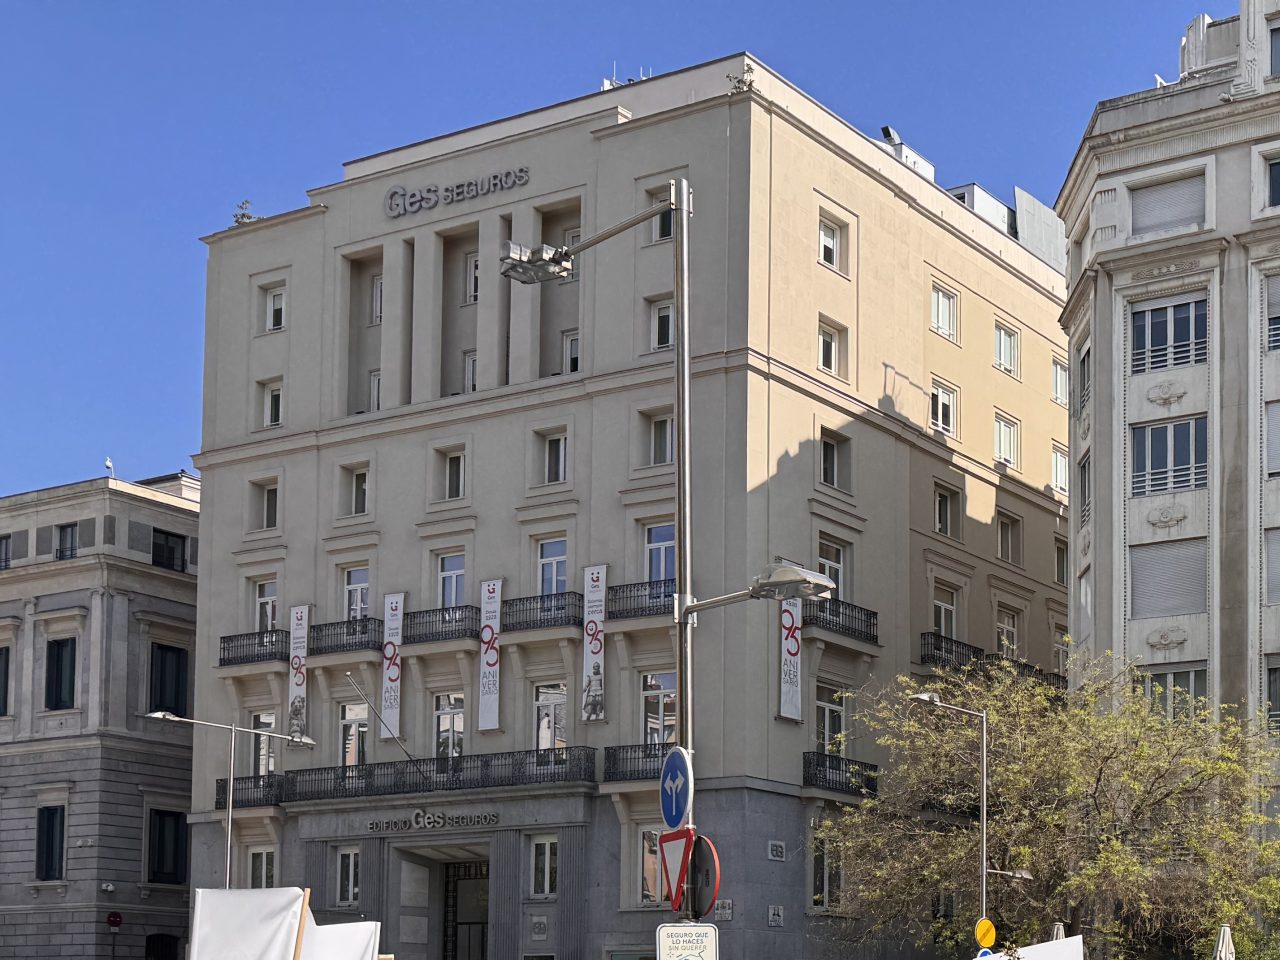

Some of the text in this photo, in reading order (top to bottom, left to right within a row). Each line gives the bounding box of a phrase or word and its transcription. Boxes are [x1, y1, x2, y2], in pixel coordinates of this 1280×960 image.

[384, 166, 529, 218] Ges SEGUROS
[586, 620, 604, 655] 95
[782, 609, 801, 657] 95
[480, 624, 499, 667] 95
[290, 655, 306, 687] 95
[383, 641, 400, 682] 95
[783, 659, 798, 671] ANI
[482, 670, 498, 680] ANI
[482, 680, 498, 689] VER
[783, 669, 798, 679] VER
[384, 686, 399, 695] ANI
[384, 695, 398, 705] VER
[367, 809, 498, 832] EDIFICIO Ges SEGUROS
